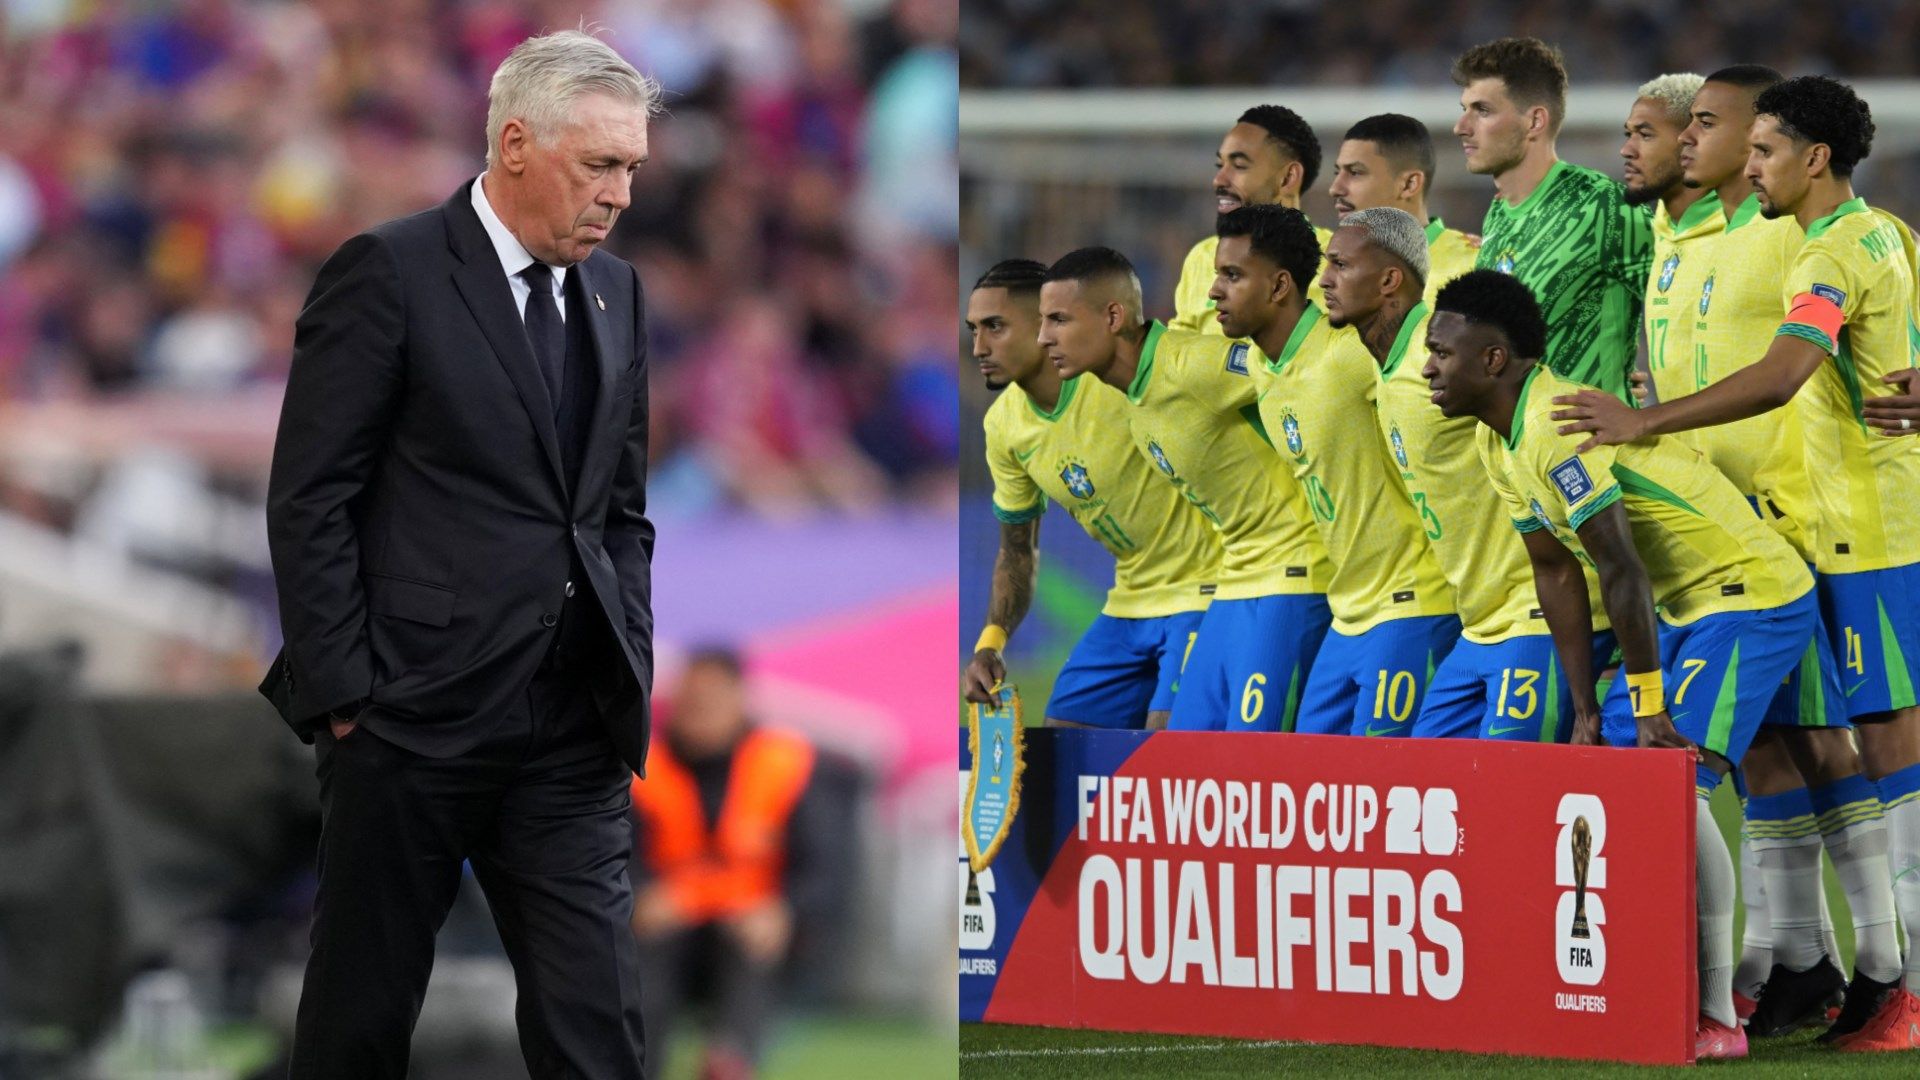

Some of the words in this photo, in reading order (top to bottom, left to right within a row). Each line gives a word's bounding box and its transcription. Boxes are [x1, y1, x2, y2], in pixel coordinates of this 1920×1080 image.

[1651, 319, 1668, 371] 17
[1302, 475, 1335, 523] 10
[1412, 492, 1442, 540] 3
[1091, 514, 1135, 551] 11
[1181, 632, 1198, 675] 1
[1845, 626, 1863, 675] 4
[1241, 673, 1267, 723] 6
[1374, 669, 1416, 722] 10
[1496, 668, 1540, 720] 13
[1674, 659, 1707, 705] 7
[1079, 775, 1155, 843] FIFA
[1161, 778, 1296, 849] WORLD
[1304, 782, 1378, 853] CUP
[1385, 786, 1458, 856] 26
[964, 915, 984, 933] FIFA
[1079, 854, 1464, 1001] QUALIFIERS
[959, 958, 996, 975] UALIFIERS
[1570, 947, 1593, 968] FIFA
[1555, 992, 1607, 1014] QUALIFIERS
